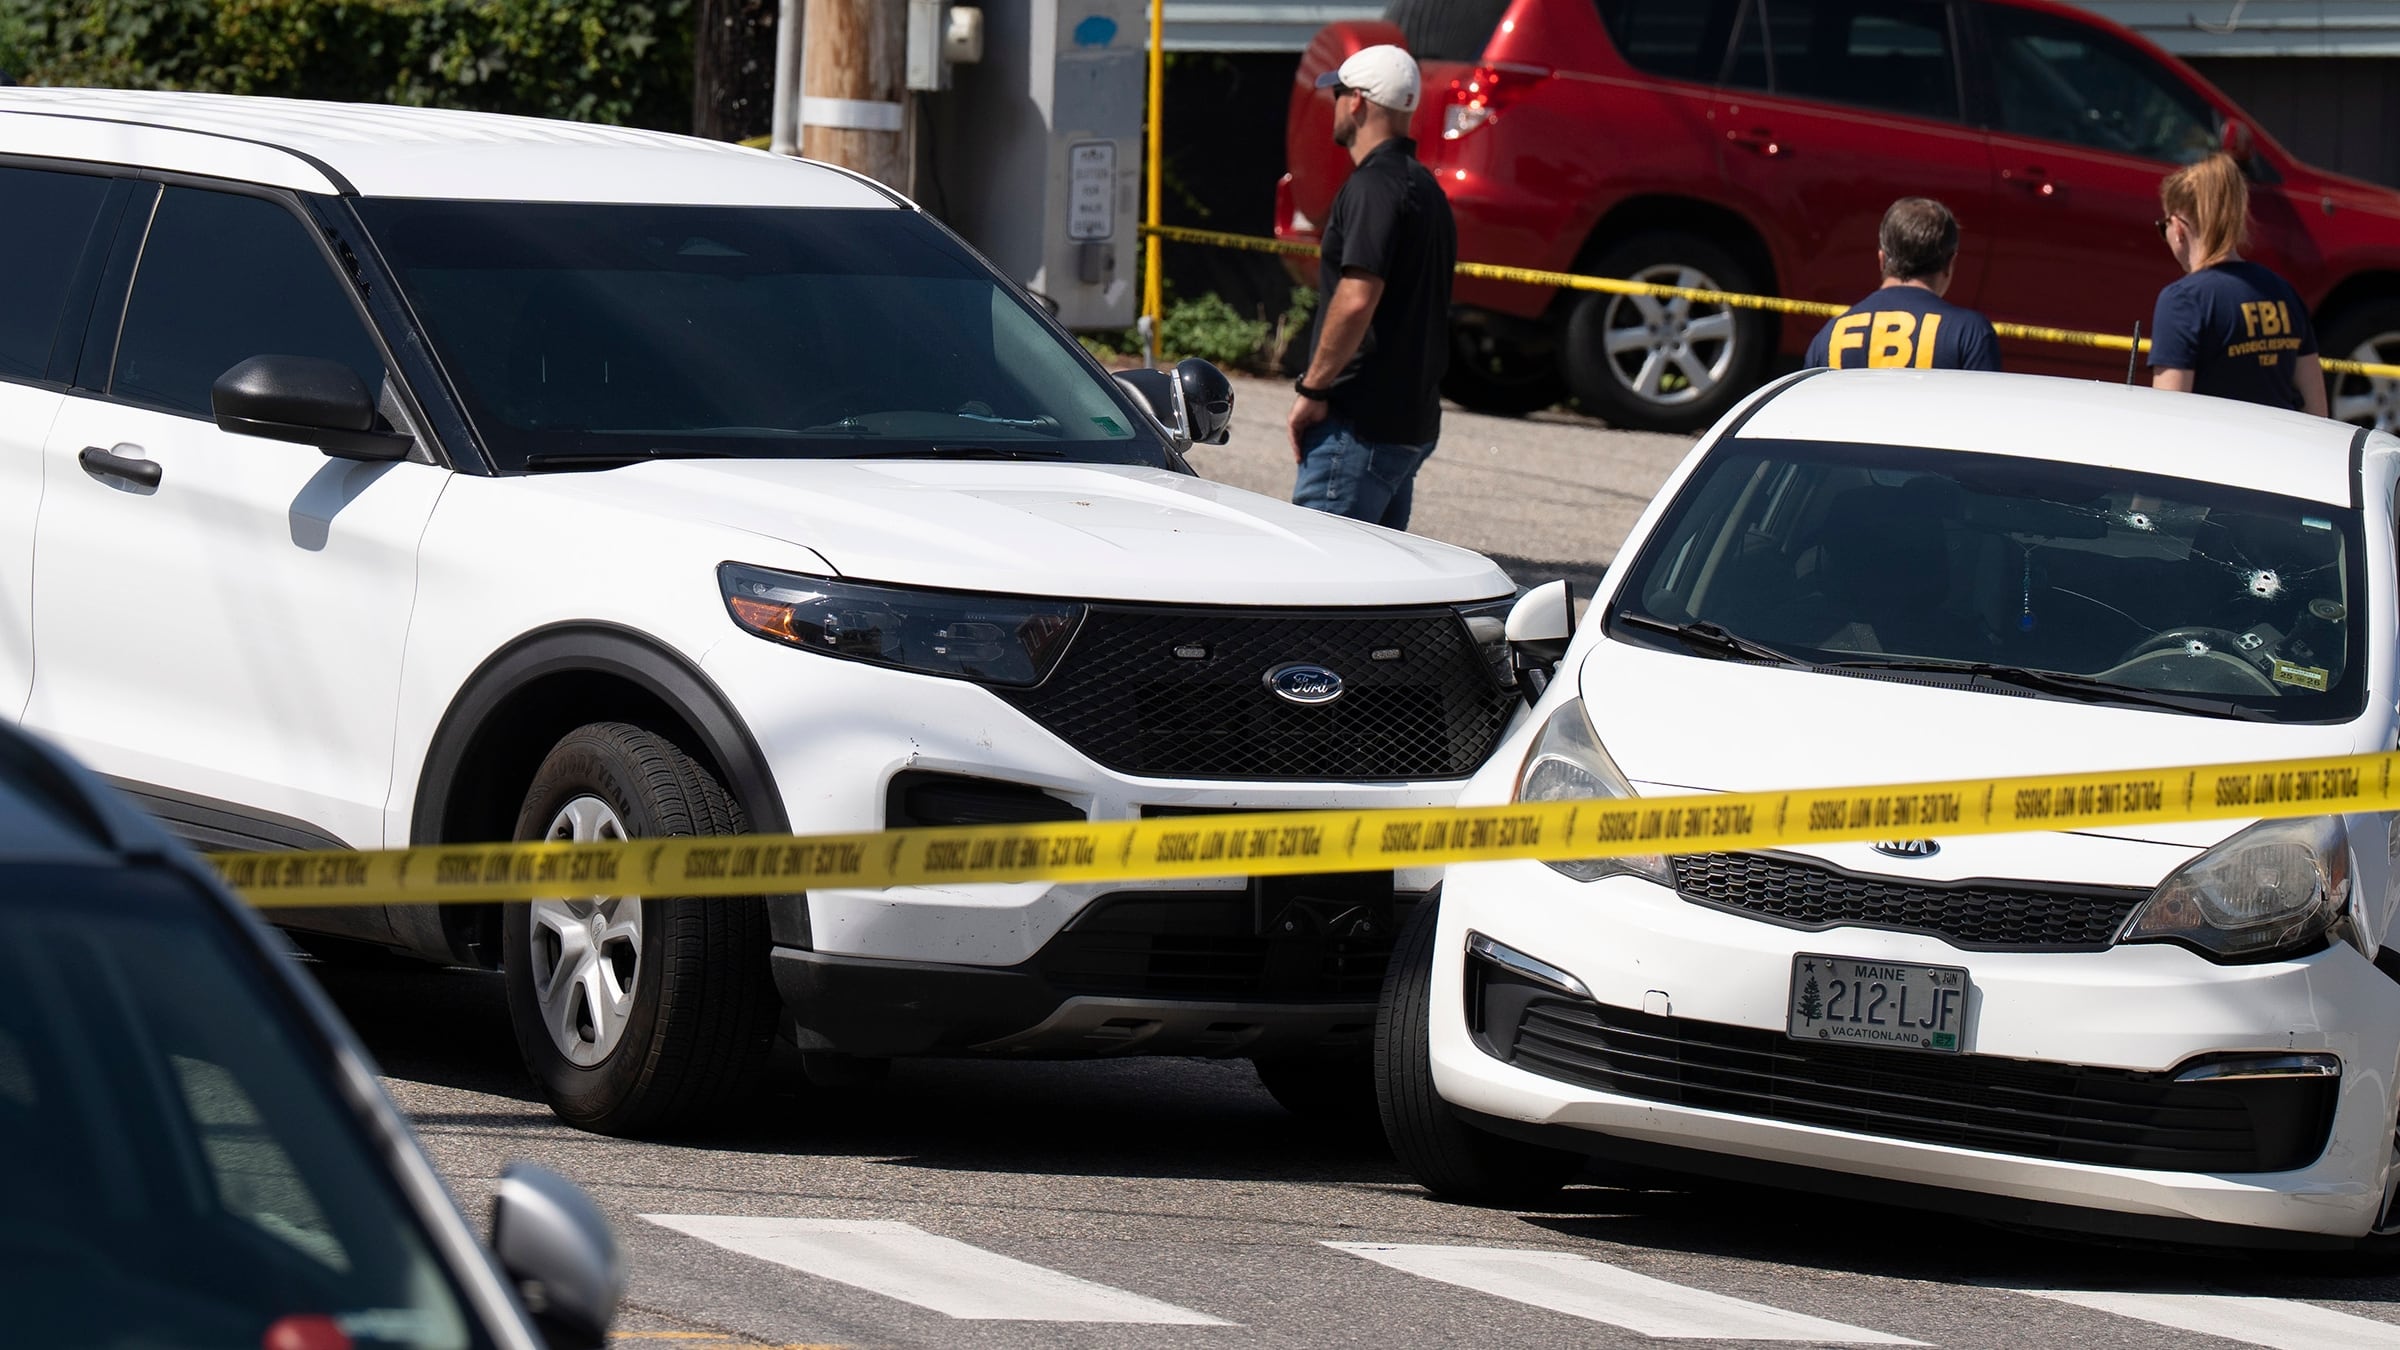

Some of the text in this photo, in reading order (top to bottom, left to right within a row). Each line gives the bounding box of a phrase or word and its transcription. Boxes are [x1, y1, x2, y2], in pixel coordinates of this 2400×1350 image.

[2241, 300, 2291, 338] FBI
[1828, 311, 1942, 370] FBI
[1291, 673, 1329, 694] Ford
[2281, 672, 2293, 680] 25
[2307, 678, 2320, 686] 26
[2123, 780, 2163, 812] POLICE
[2214, 775, 2252, 806] CROSS
[2253, 773, 2276, 803] NOT
[2277, 772, 2293, 802] DO
[2295, 770, 2319, 801] LINE
[2321, 767, 2360, 799] POLICE
[1848, 798, 1873, 829] NOT
[1874, 796, 1891, 827] DO
[1893, 795, 1919, 826] LINE
[1919, 792, 1961, 825] POLICE
[2014, 788, 2052, 819] CROSS
[2053, 786, 2076, 817] NOT
[2078, 785, 2094, 815] DO
[2096, 784, 2121, 814] LINE
[1497, 814, 1542, 847] POLICE
[1597, 811, 1638, 843] CROSS
[1638, 809, 1664, 840] NOT
[1665, 808, 1683, 838] DO
[1683, 807, 1711, 838] LINE
[1711, 803, 1756, 836] POLICE
[1809, 799, 1847, 831] CROSS
[1155, 832, 1199, 862] CROSS
[1199, 830, 1226, 860] NOT
[1227, 829, 1247, 859] DO
[1248, 828, 1277, 858] LINE
[1277, 824, 1325, 857] POLICE
[1380, 821, 1423, 852] CROSS
[1422, 820, 1449, 850] NOT
[1449, 819, 1468, 849] DO
[1468, 817, 1498, 848] LINE
[1855, 965, 1905, 982] MAINE
[1942, 972, 1958, 985] JUN
[1831, 1026, 1919, 1043] VACATIONLAND
